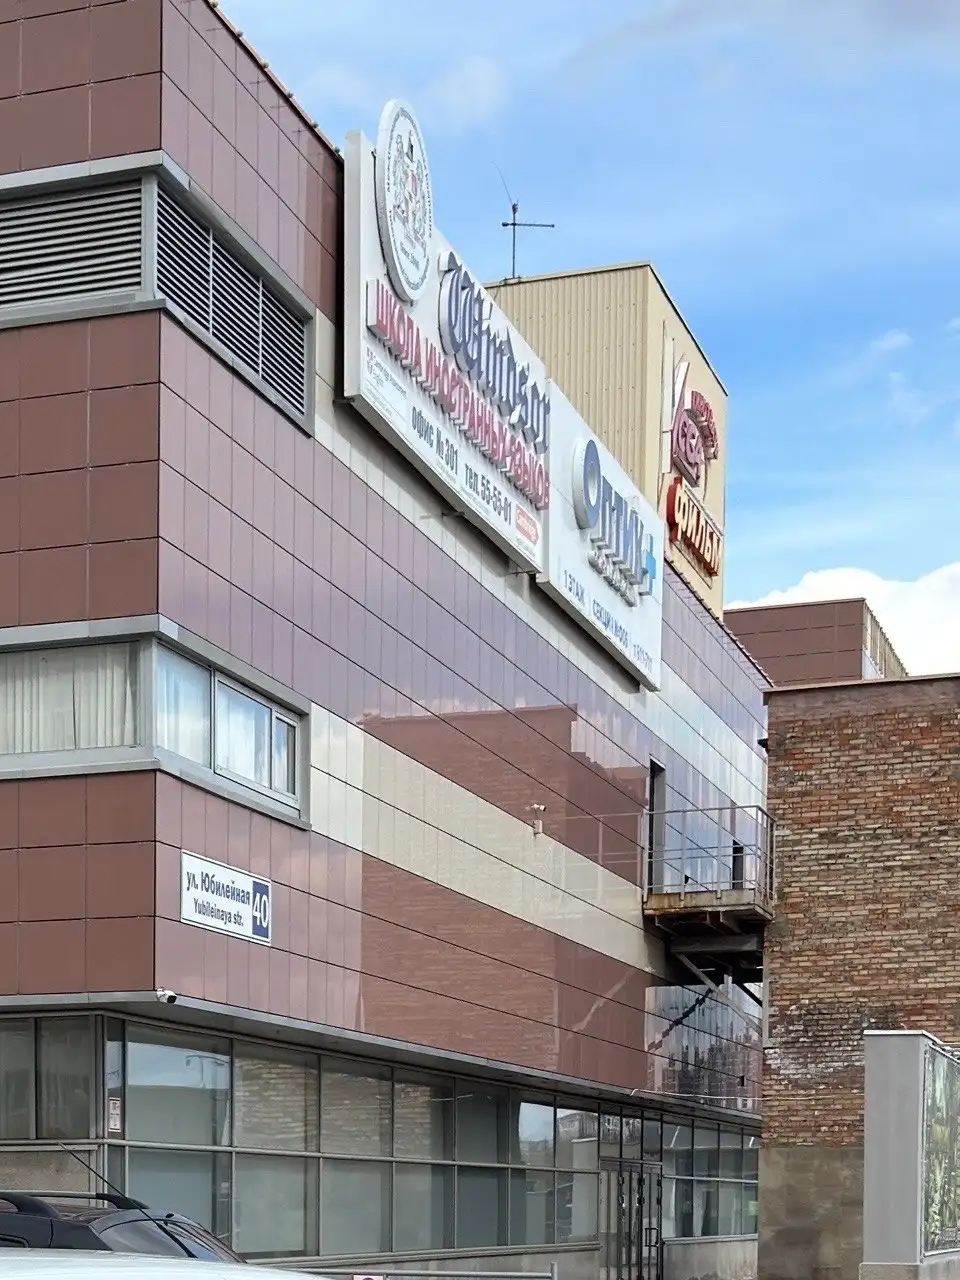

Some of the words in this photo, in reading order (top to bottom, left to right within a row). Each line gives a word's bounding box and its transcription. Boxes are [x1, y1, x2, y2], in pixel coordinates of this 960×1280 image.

[376, 278, 422, 371] ШКОЛА
[425, 337, 508, 466] ИНОСТРАННЫХ
[480, 474, 512, 526] 55-55-01
[673, 476, 723, 576] ФИЛЬМ
[186, 871, 199, 892] ул.
[200, 871, 251, 906] Юбилейная
[252, 892, 269, 928] 40
[193, 897, 232, 925] Yubileinaya
[233, 910, 244, 927] str.
